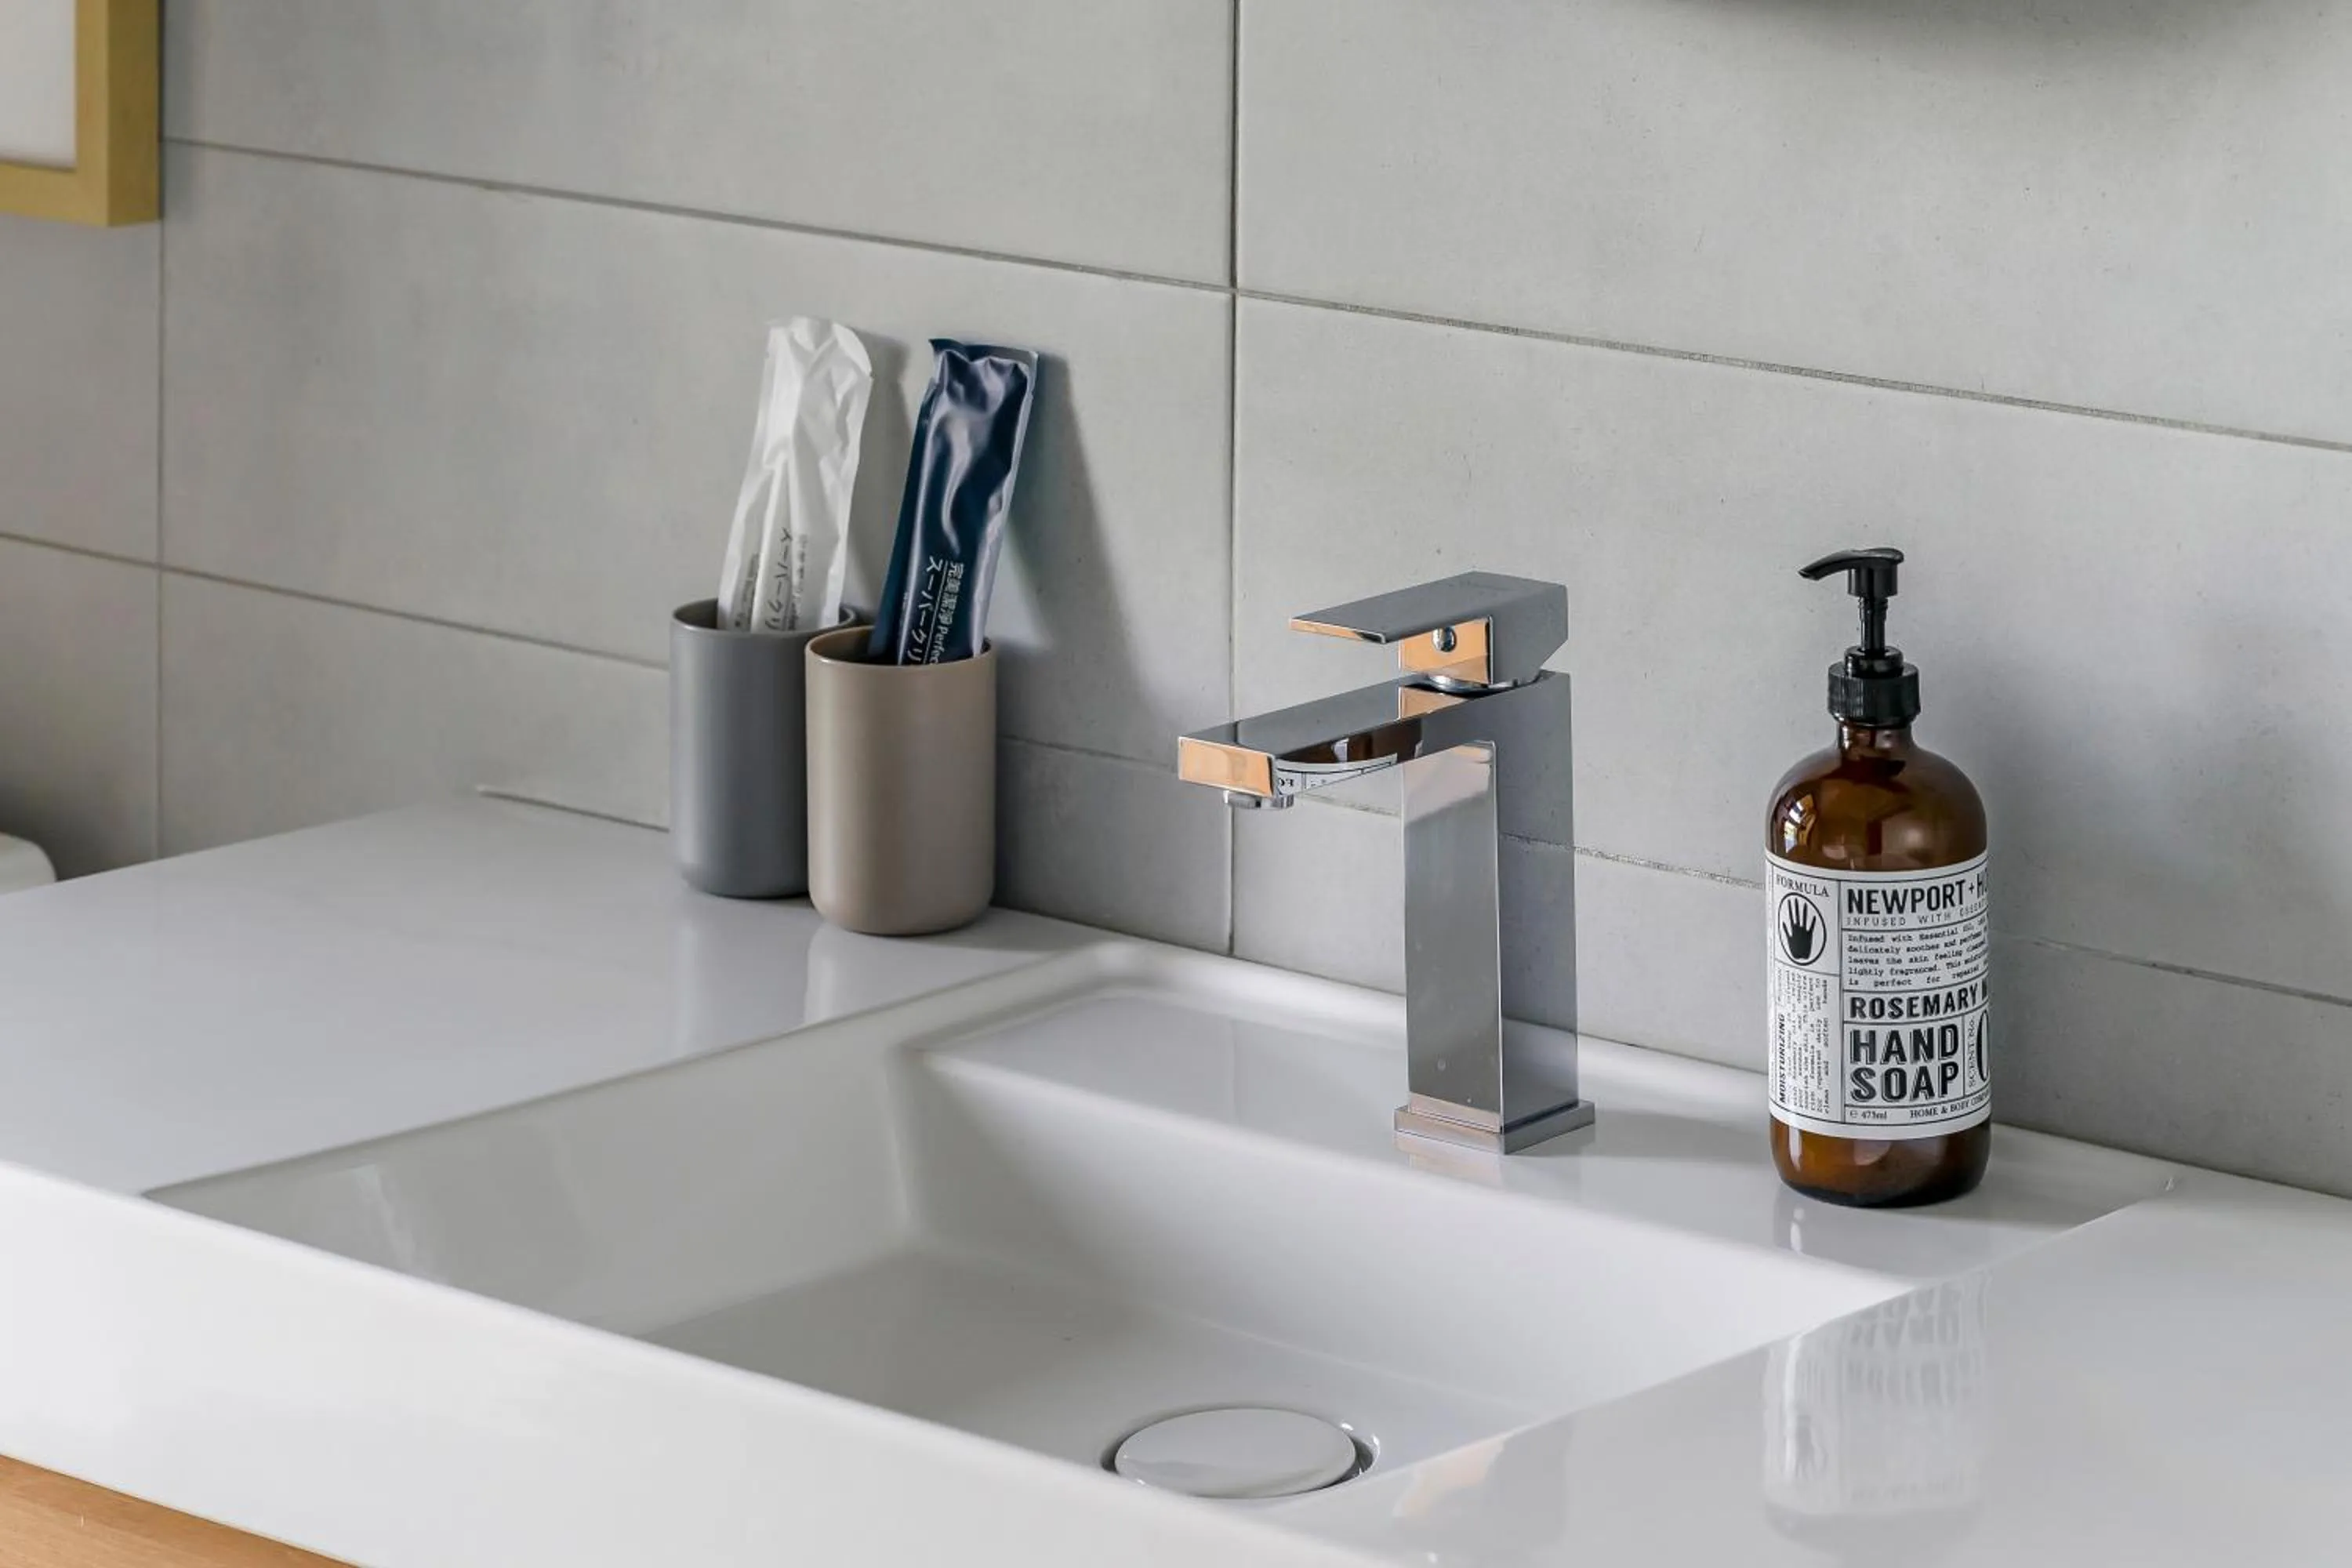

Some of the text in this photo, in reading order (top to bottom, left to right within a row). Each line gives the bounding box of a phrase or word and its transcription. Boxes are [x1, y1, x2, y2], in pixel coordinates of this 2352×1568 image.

[1776, 874, 1829, 897] FORMULA
[1848, 880, 1965, 914] NEWPORT
[1847, 917, 1906, 927] INFUSED
[1918, 913, 1951, 924] WITH
[1850, 983, 1978, 1019] ROSEMARY
[1850, 1023, 1958, 1065] HAND
[1850, 1061, 1959, 1103] SOAP
[1910, 1107, 1938, 1119] HOME
